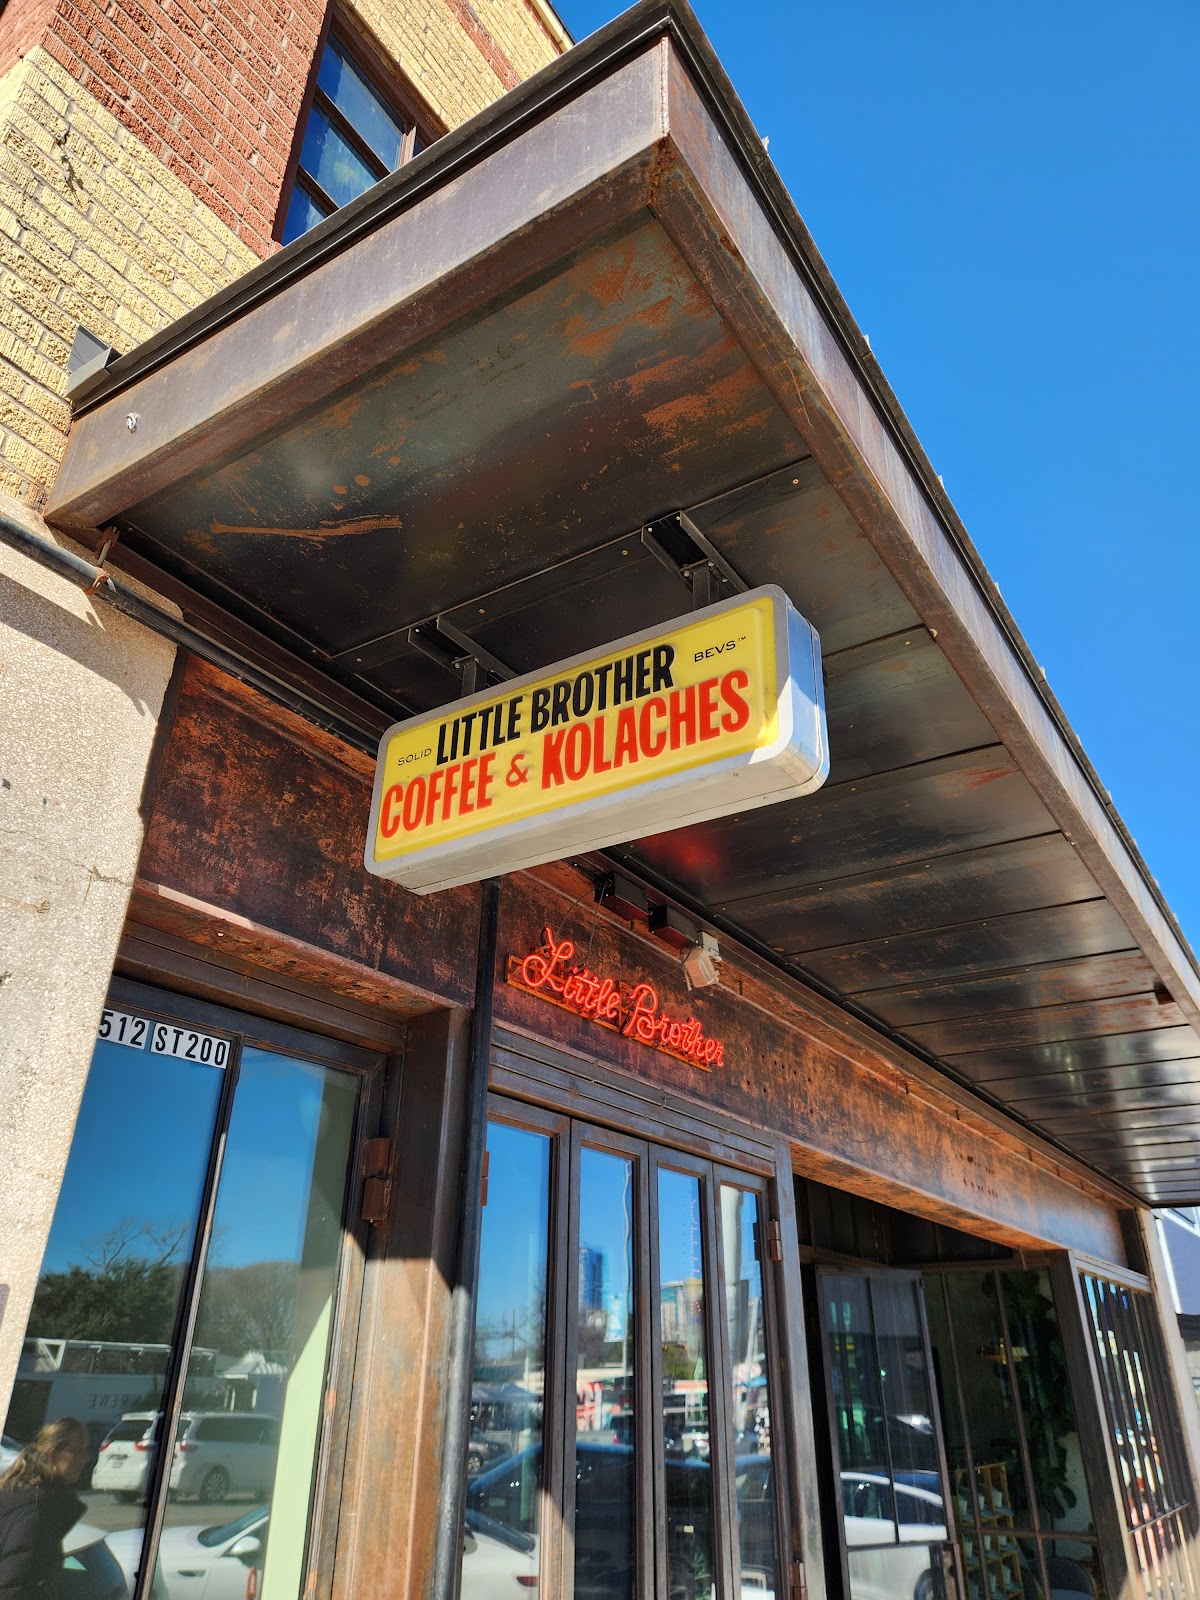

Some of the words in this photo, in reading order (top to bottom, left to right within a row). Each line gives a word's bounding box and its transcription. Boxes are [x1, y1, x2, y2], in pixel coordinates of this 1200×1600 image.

[380, 752, 496, 839] COFFEE
[505, 753, 529, 788] &
[541, 669, 750, 790] KOLACHES
[398, 748, 432, 766] SOLID
[436, 697, 523, 765] LITTLE
[530, 644, 675, 734] BROTHER
[98, 1011, 146, 1047] 512
[522, 926, 621, 1019] Little
[622, 982, 724, 1067] Brother
